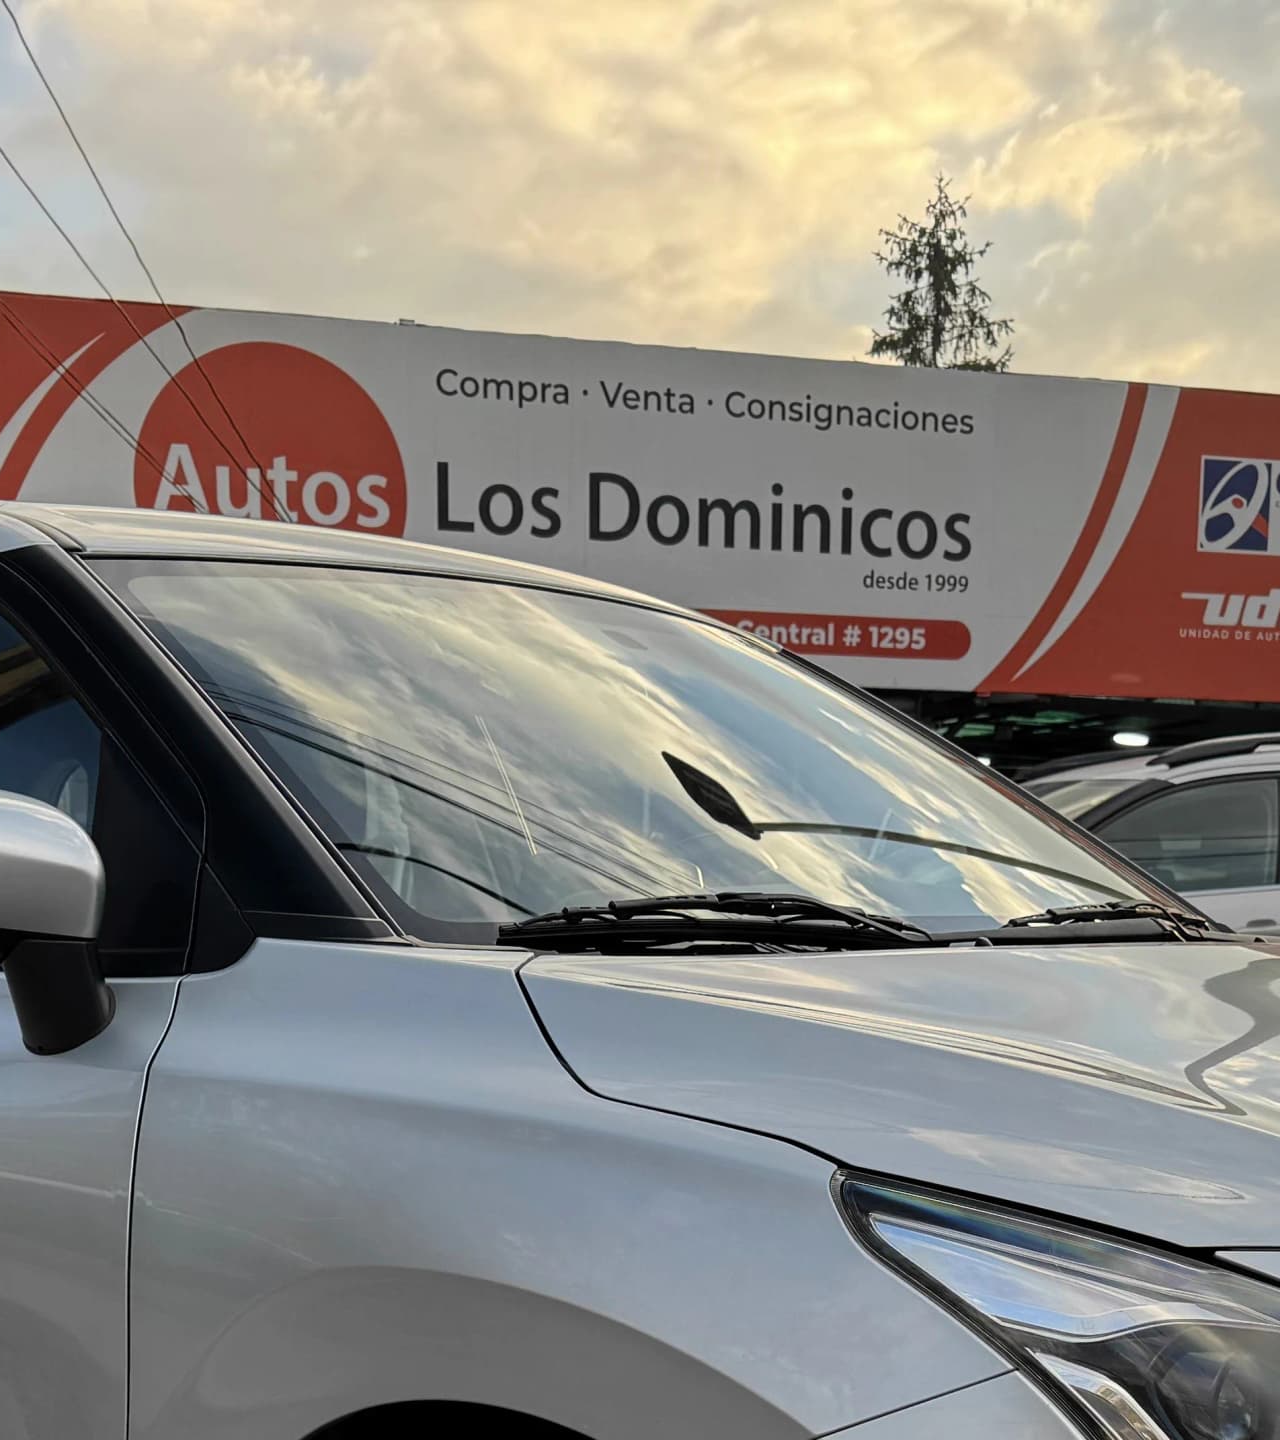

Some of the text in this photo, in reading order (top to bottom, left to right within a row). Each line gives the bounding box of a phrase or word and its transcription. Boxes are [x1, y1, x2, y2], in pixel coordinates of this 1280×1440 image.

[435, 368, 570, 408] Compra
[600, 380, 696, 414] Venta
[724, 391, 975, 435] Consignaciones
[153, 443, 973, 563] Autos Los Dominicos
[862, 569, 969, 593] desde 1999
[867, 626, 927, 650] 1295
[1179, 628, 1229, 640] UNIDAD
[1234, 630, 1252, 641] DE
